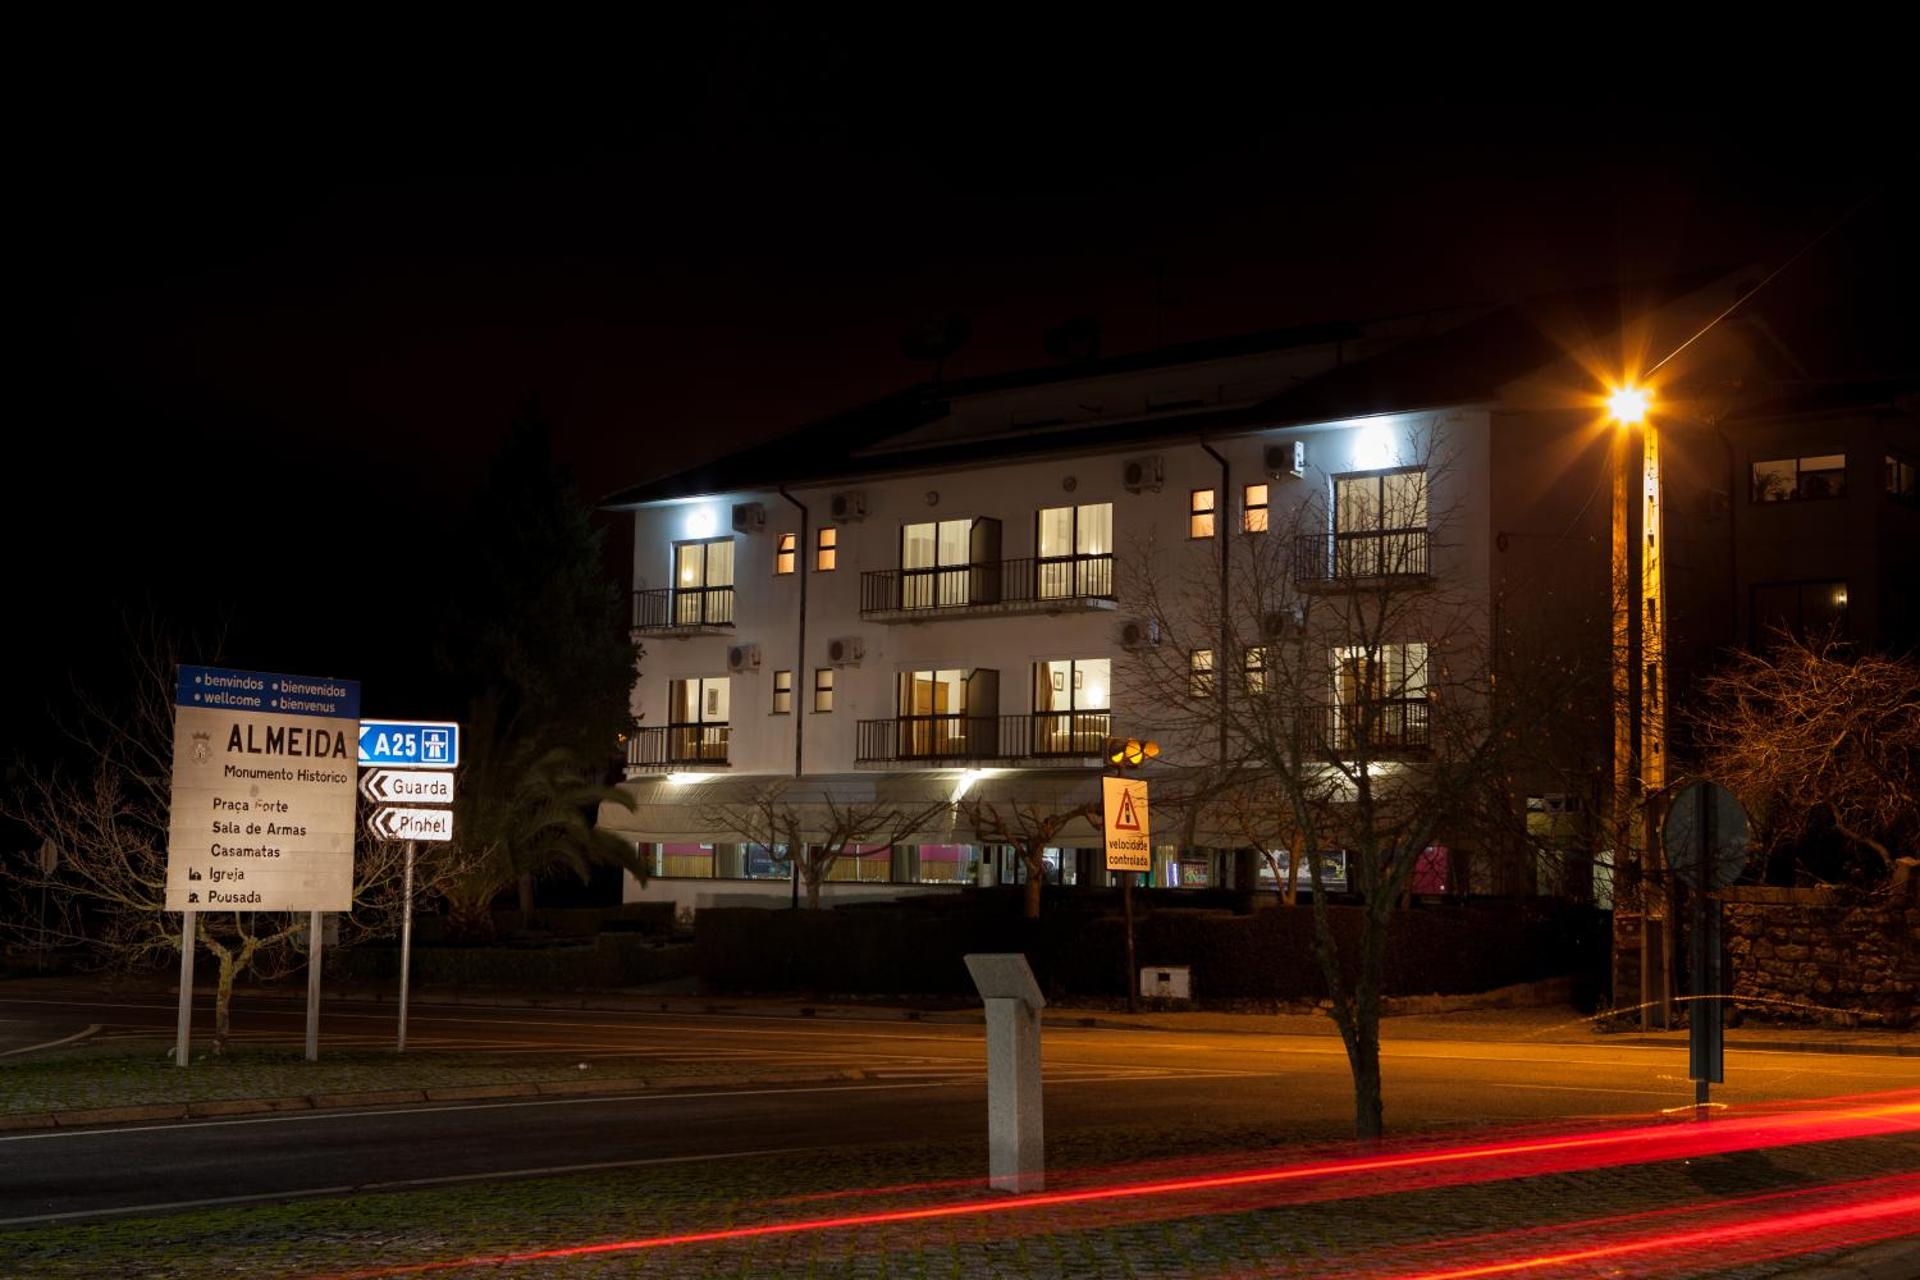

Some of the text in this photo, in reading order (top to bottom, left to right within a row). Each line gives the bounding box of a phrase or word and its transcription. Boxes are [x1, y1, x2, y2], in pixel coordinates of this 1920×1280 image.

[205, 674, 346, 697] benvindos bienvenidos
[204, 692, 336, 713] wellcome bienvenus
[227, 724, 347, 758] ALMEIDA
[374, 733, 416, 757] A25
[224, 765, 293, 780] Monumento
[393, 779, 447, 795] Guarda
[213, 798, 249, 814] Praça
[213, 822, 306, 836] Sala de Armas
[400, 816, 445, 834] Pinhel
[211, 844, 280, 858] Casamatas
[1109, 839, 1147, 851] velocidade
[1109, 855, 1148, 866] controlada
[209, 868, 245, 881] Igreja
[208, 890, 261, 903] Pousada
